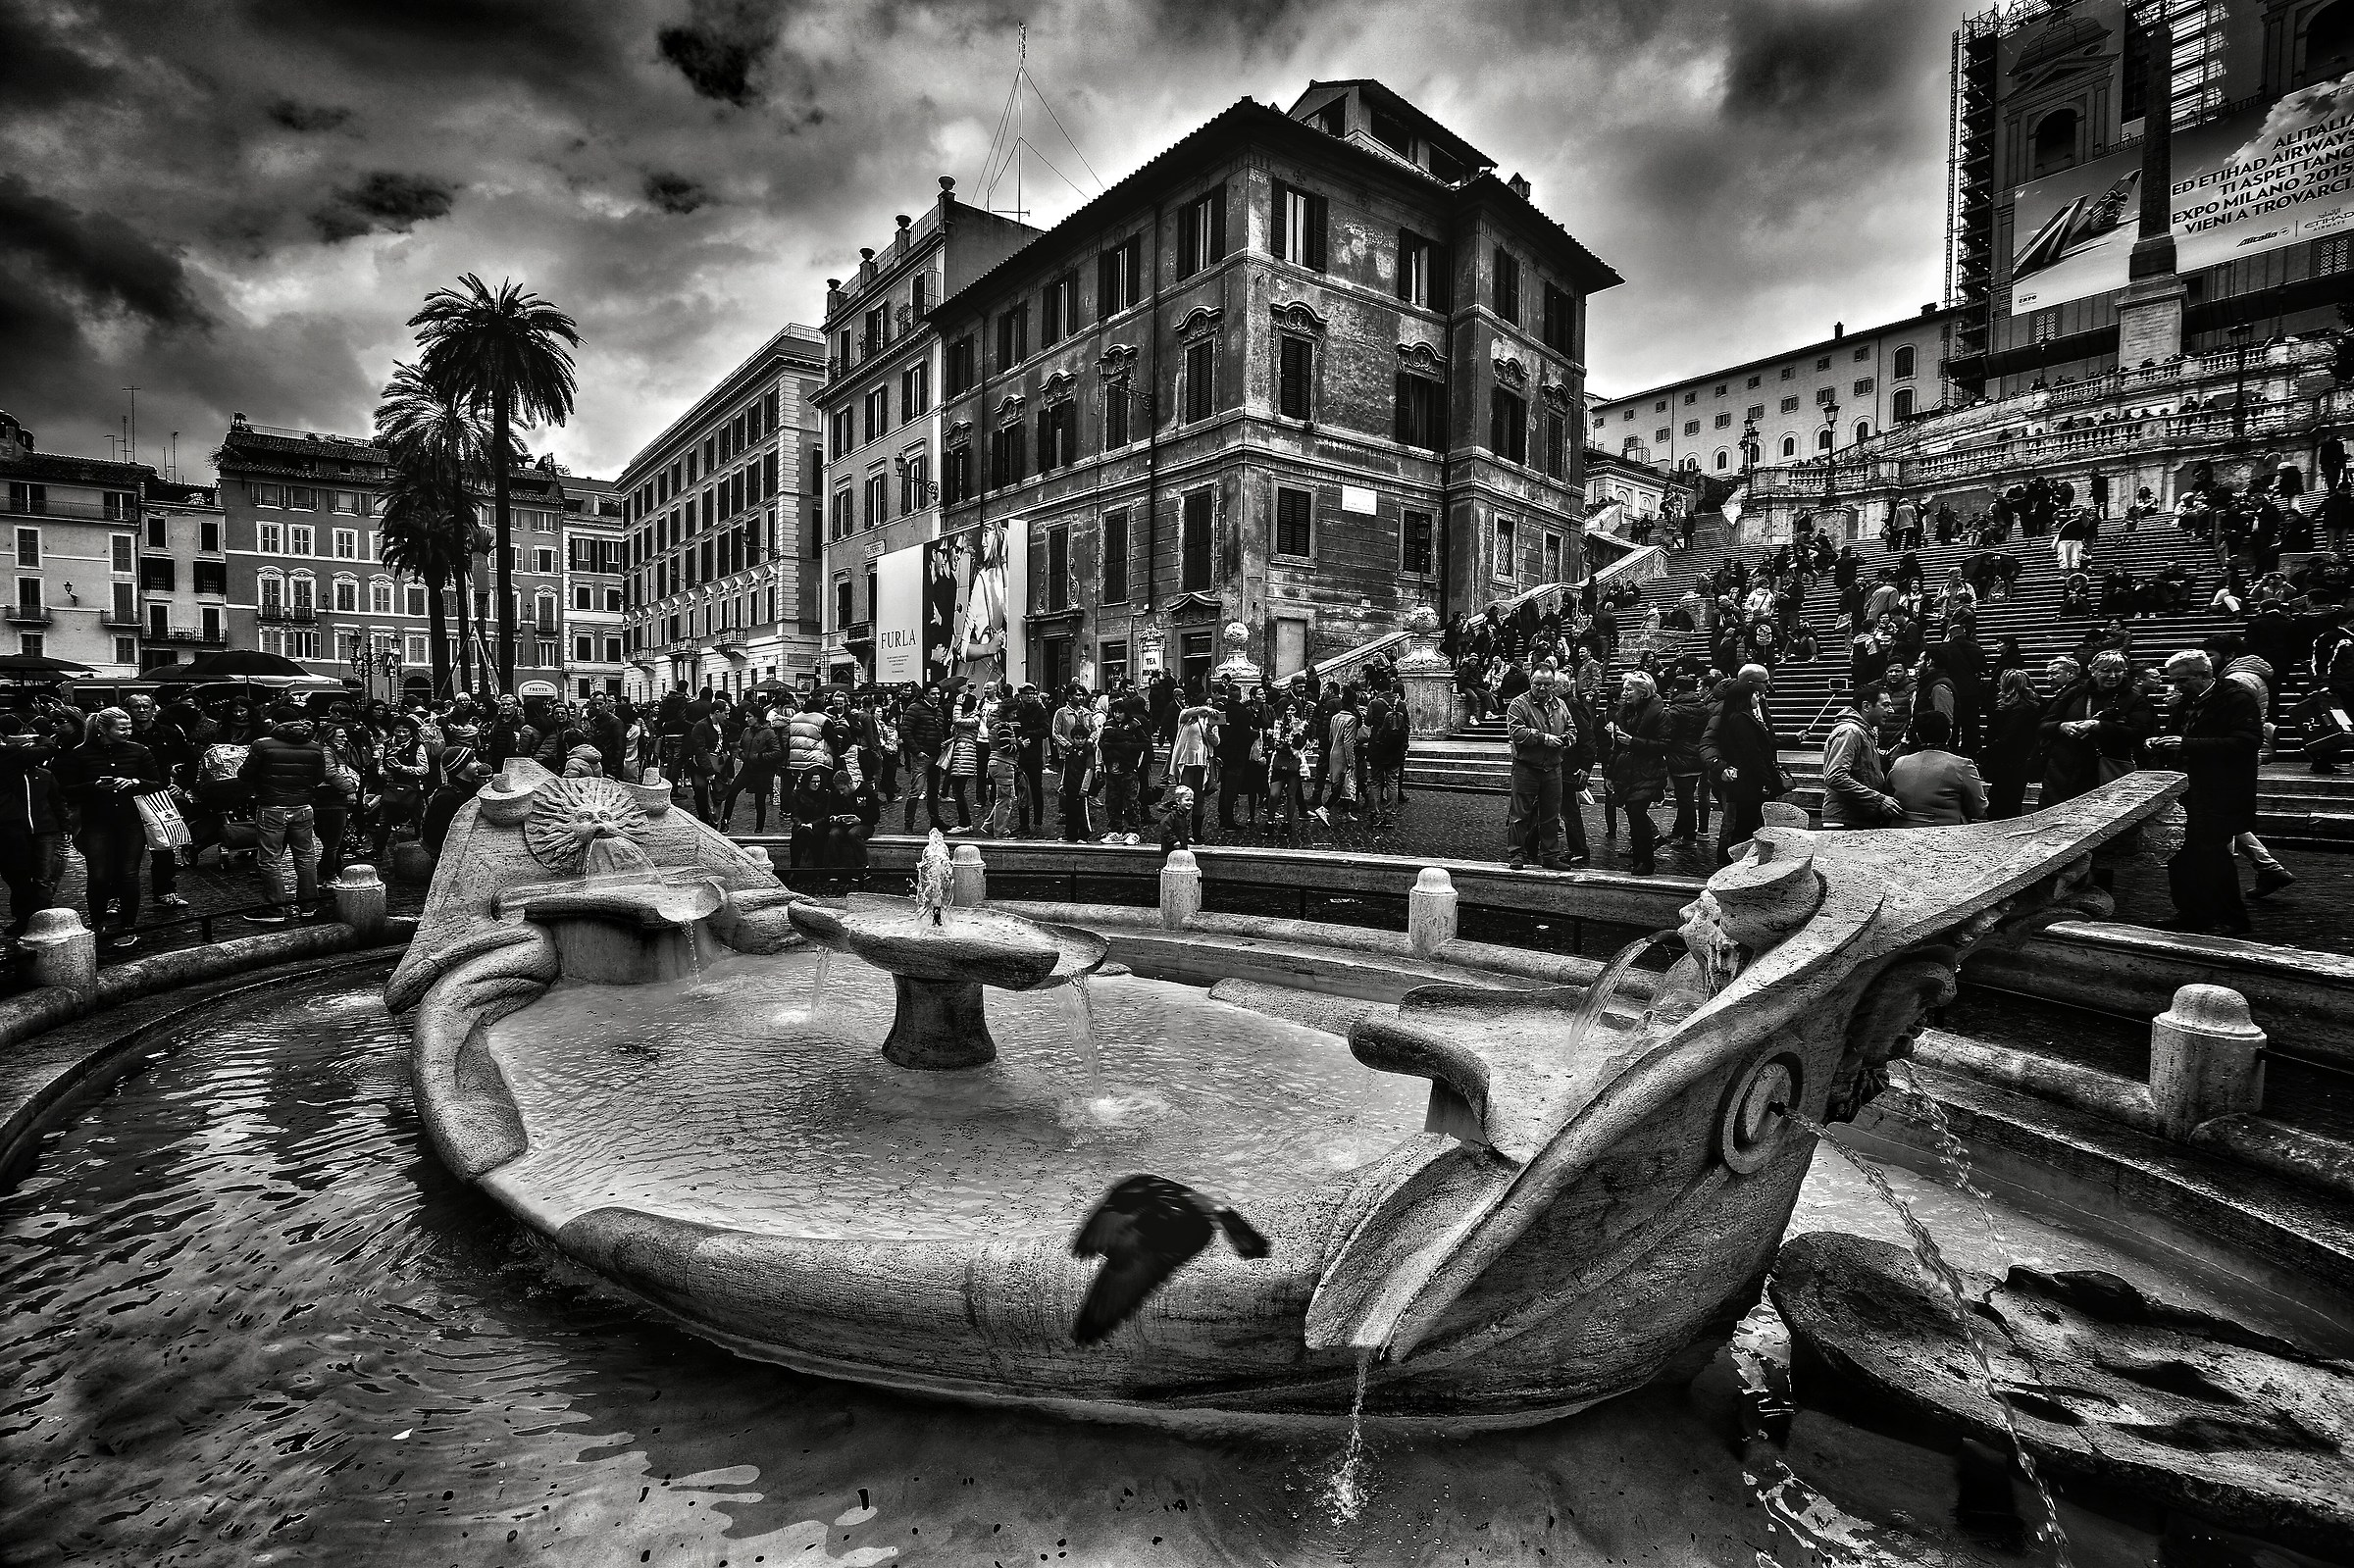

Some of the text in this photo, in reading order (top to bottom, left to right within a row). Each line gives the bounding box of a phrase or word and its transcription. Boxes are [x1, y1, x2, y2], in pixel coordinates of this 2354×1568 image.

[2272, 113, 2354, 150] ALITALIA
[2172, 128, 2354, 196] ED ETIHAD AIRWAYS
[2220, 144, 2354, 196] TI ASPETTANO
[2172, 201, 2220, 225] EXPO
[2224, 177, 2300, 210] MILANO
[2184, 214, 2232, 234] VIENI
[2235, 208, 2248, 222] A
[881, 629, 917, 649] FURLA
